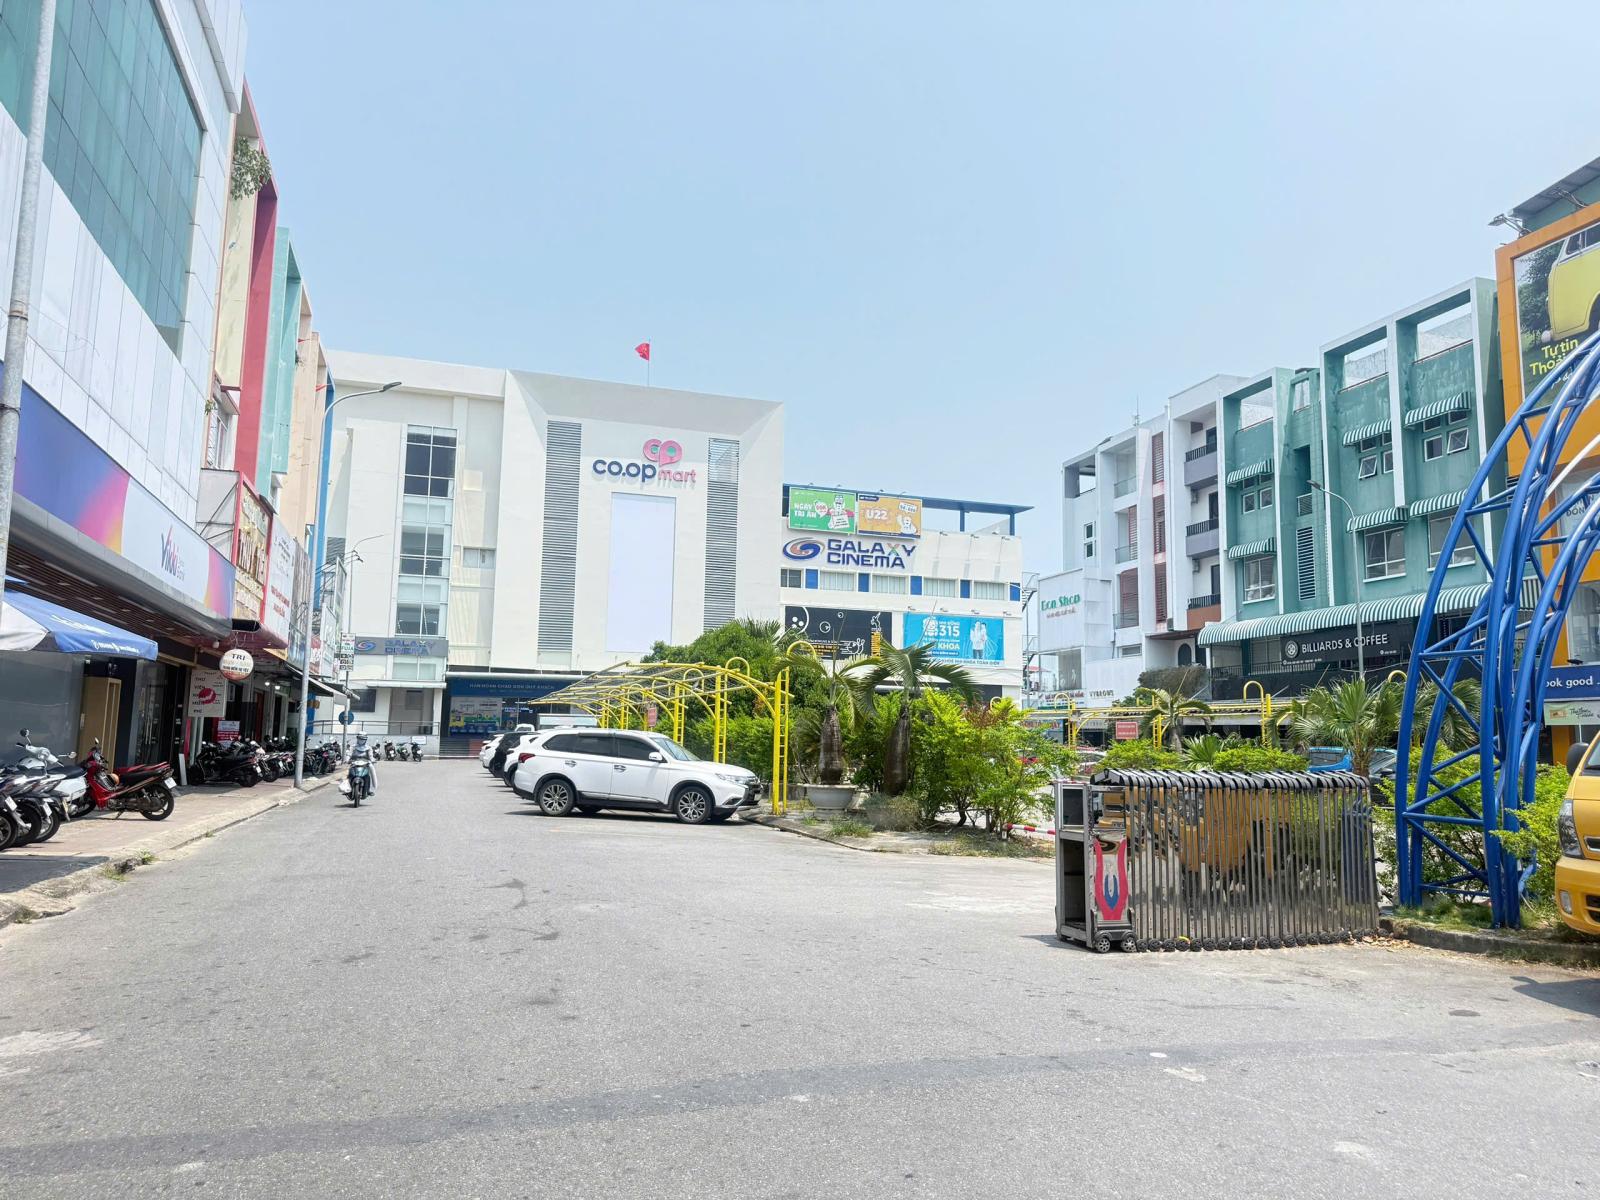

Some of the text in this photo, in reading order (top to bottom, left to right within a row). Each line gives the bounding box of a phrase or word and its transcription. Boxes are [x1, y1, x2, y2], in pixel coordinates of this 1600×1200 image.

[1541, 338, 1579, 359] Tự tin
[866, 508, 888, 520] U22
[827, 538, 917, 556] GALAXY
[827, 552, 906, 569] CINEMA
[939, 625, 960, 637] 315
[1301, 633, 1388, 654] BILLIARDS & COFFEE
[232, 653, 246, 661] TRI
[1566, 675, 1594, 689] good
